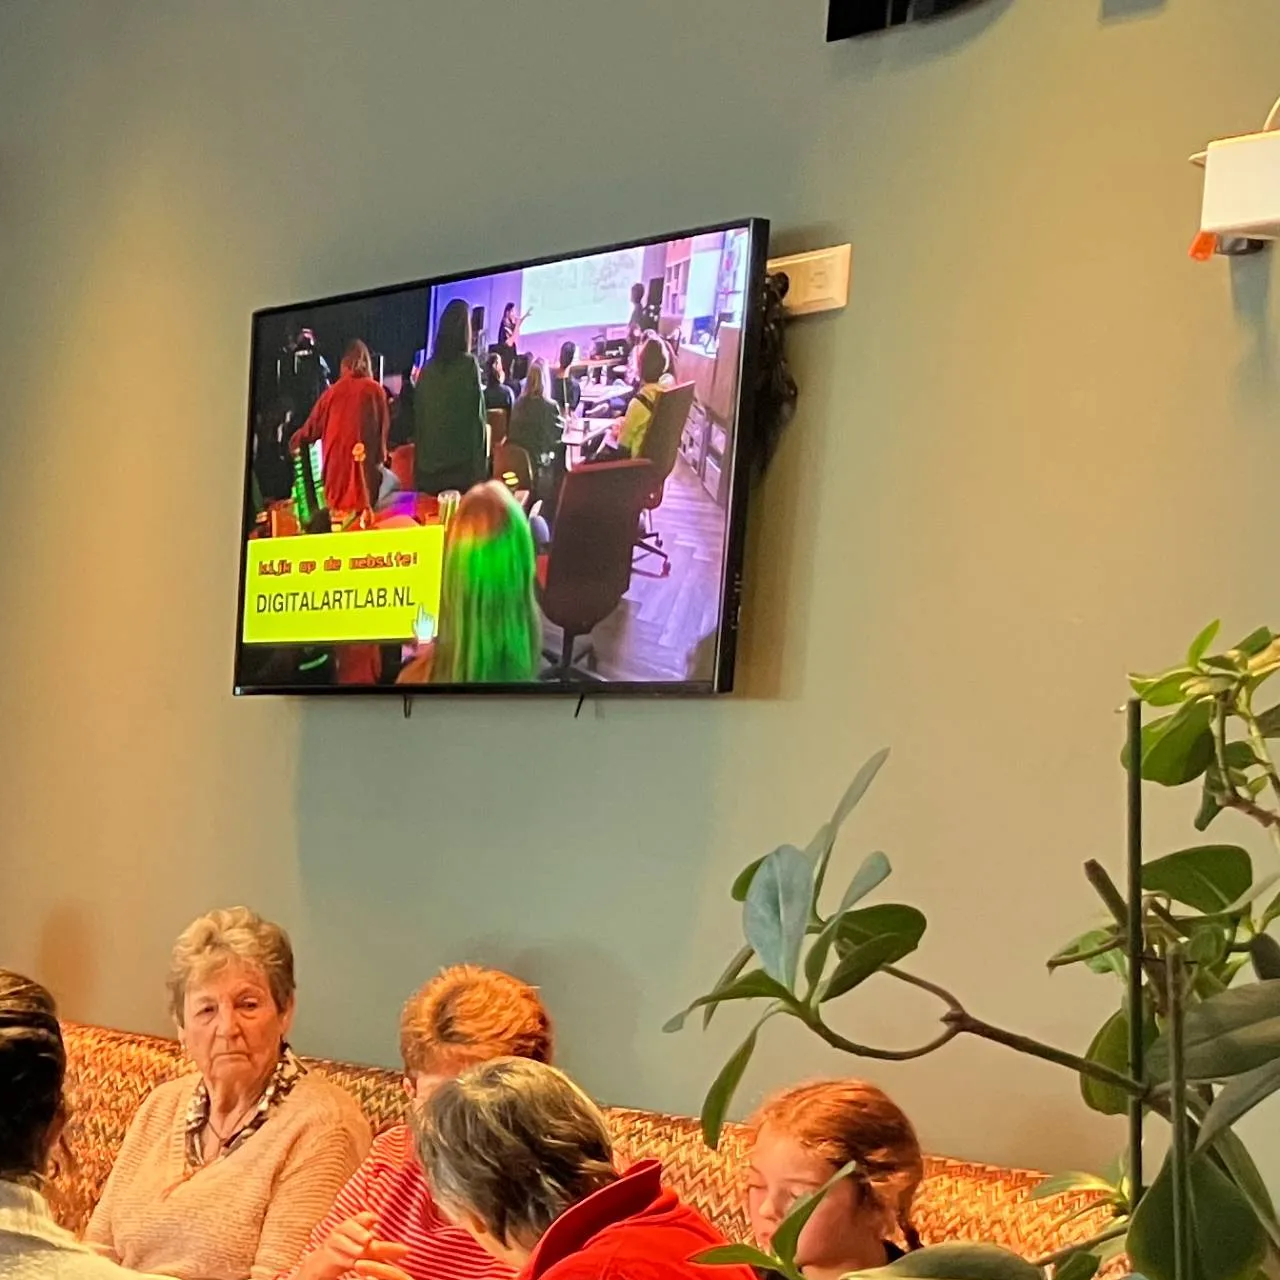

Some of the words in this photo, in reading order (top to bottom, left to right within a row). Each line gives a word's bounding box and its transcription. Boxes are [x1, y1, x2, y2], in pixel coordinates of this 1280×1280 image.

[299, 561, 317, 575] op
[323, 556, 342, 572] de
[256, 586, 416, 613] DIGITALARTLAB.NL
